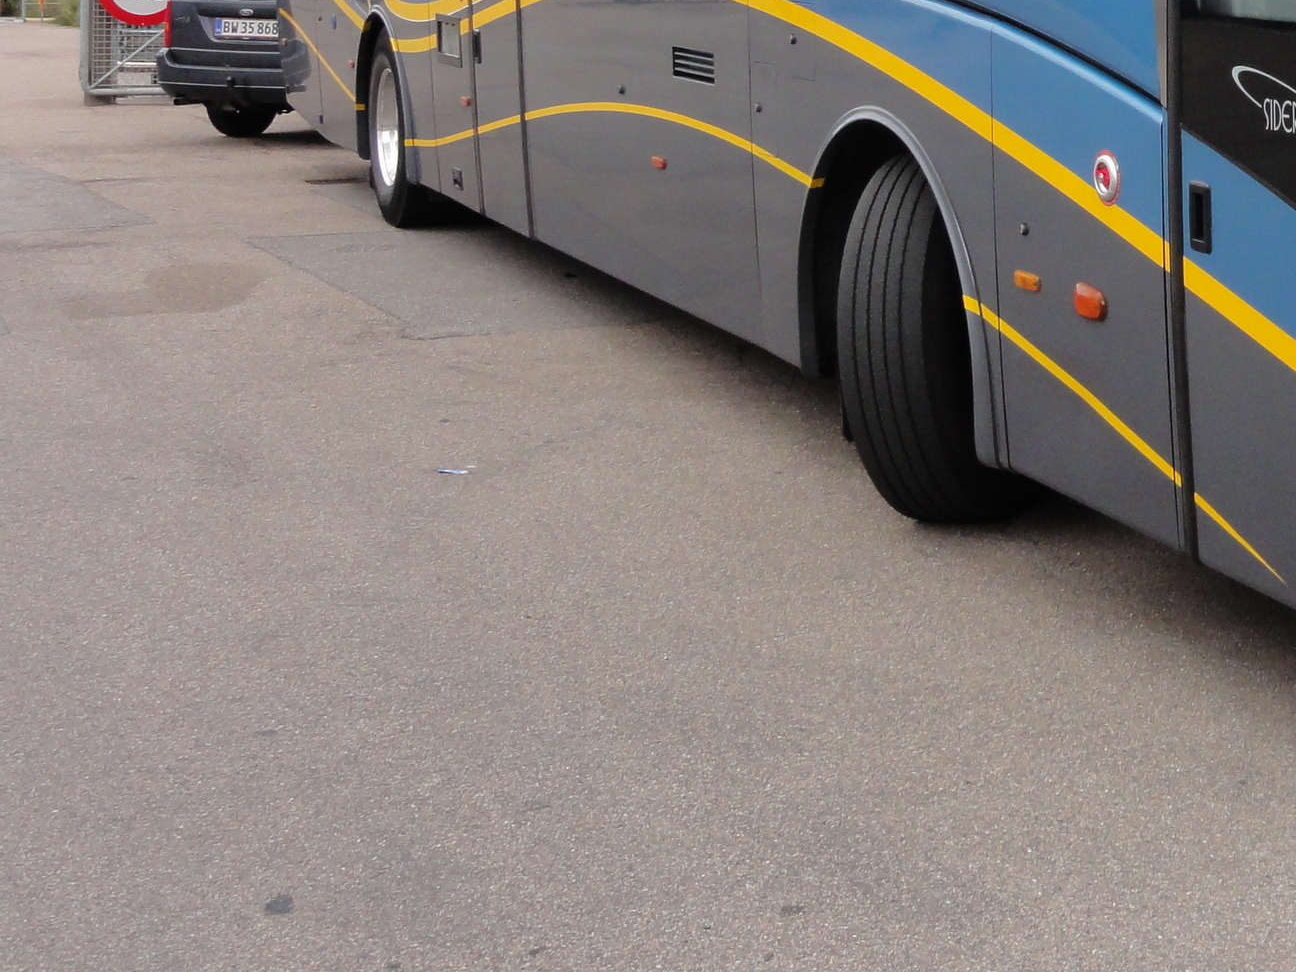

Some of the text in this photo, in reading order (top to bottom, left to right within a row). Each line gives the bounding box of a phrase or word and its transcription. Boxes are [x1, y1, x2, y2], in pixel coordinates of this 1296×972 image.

[223, 21, 279, 35] BW 35 868
